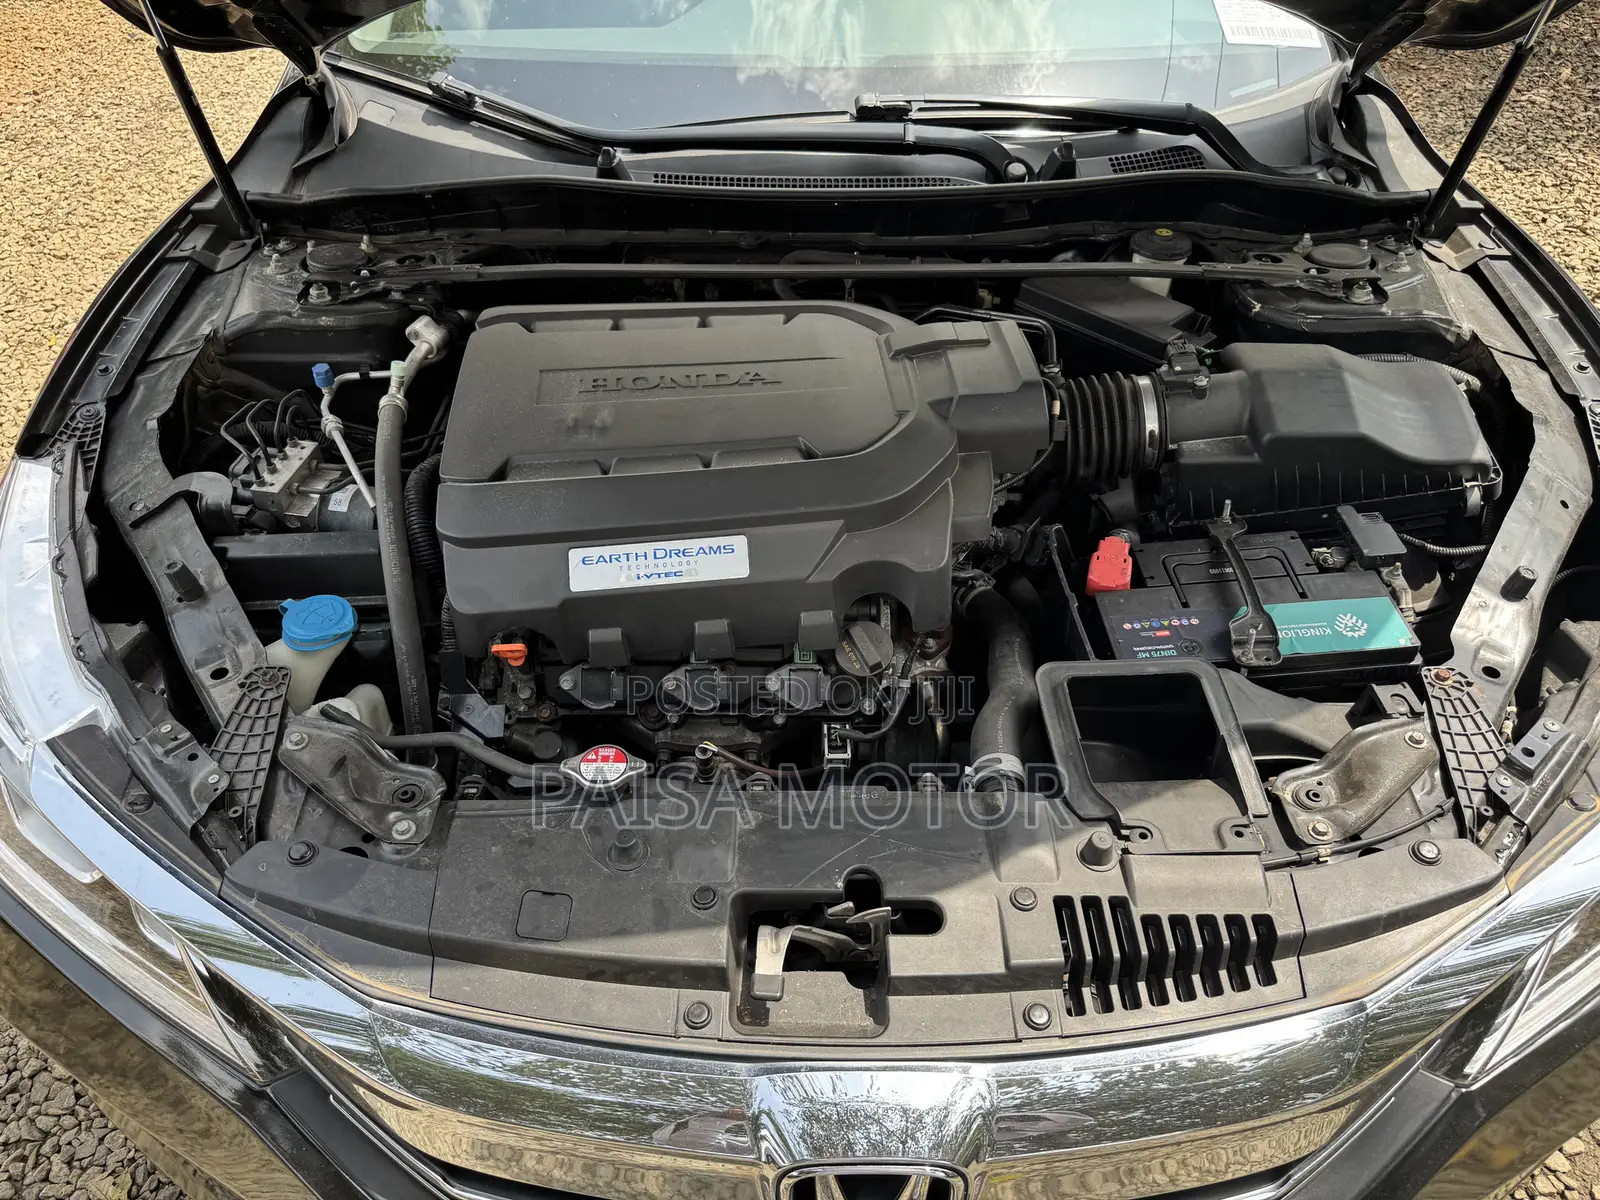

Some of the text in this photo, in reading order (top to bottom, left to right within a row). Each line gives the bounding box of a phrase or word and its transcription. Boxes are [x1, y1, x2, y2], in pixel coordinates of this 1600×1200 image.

[578, 371, 783, 393] HONDA
[581, 544, 735, 565] EARTH DREAMS
[619, 560, 699, 571] TECHNOLOGY
[841, 640, 852, 653] SAE
[1136, 649, 1177, 659] DIN75 MF
